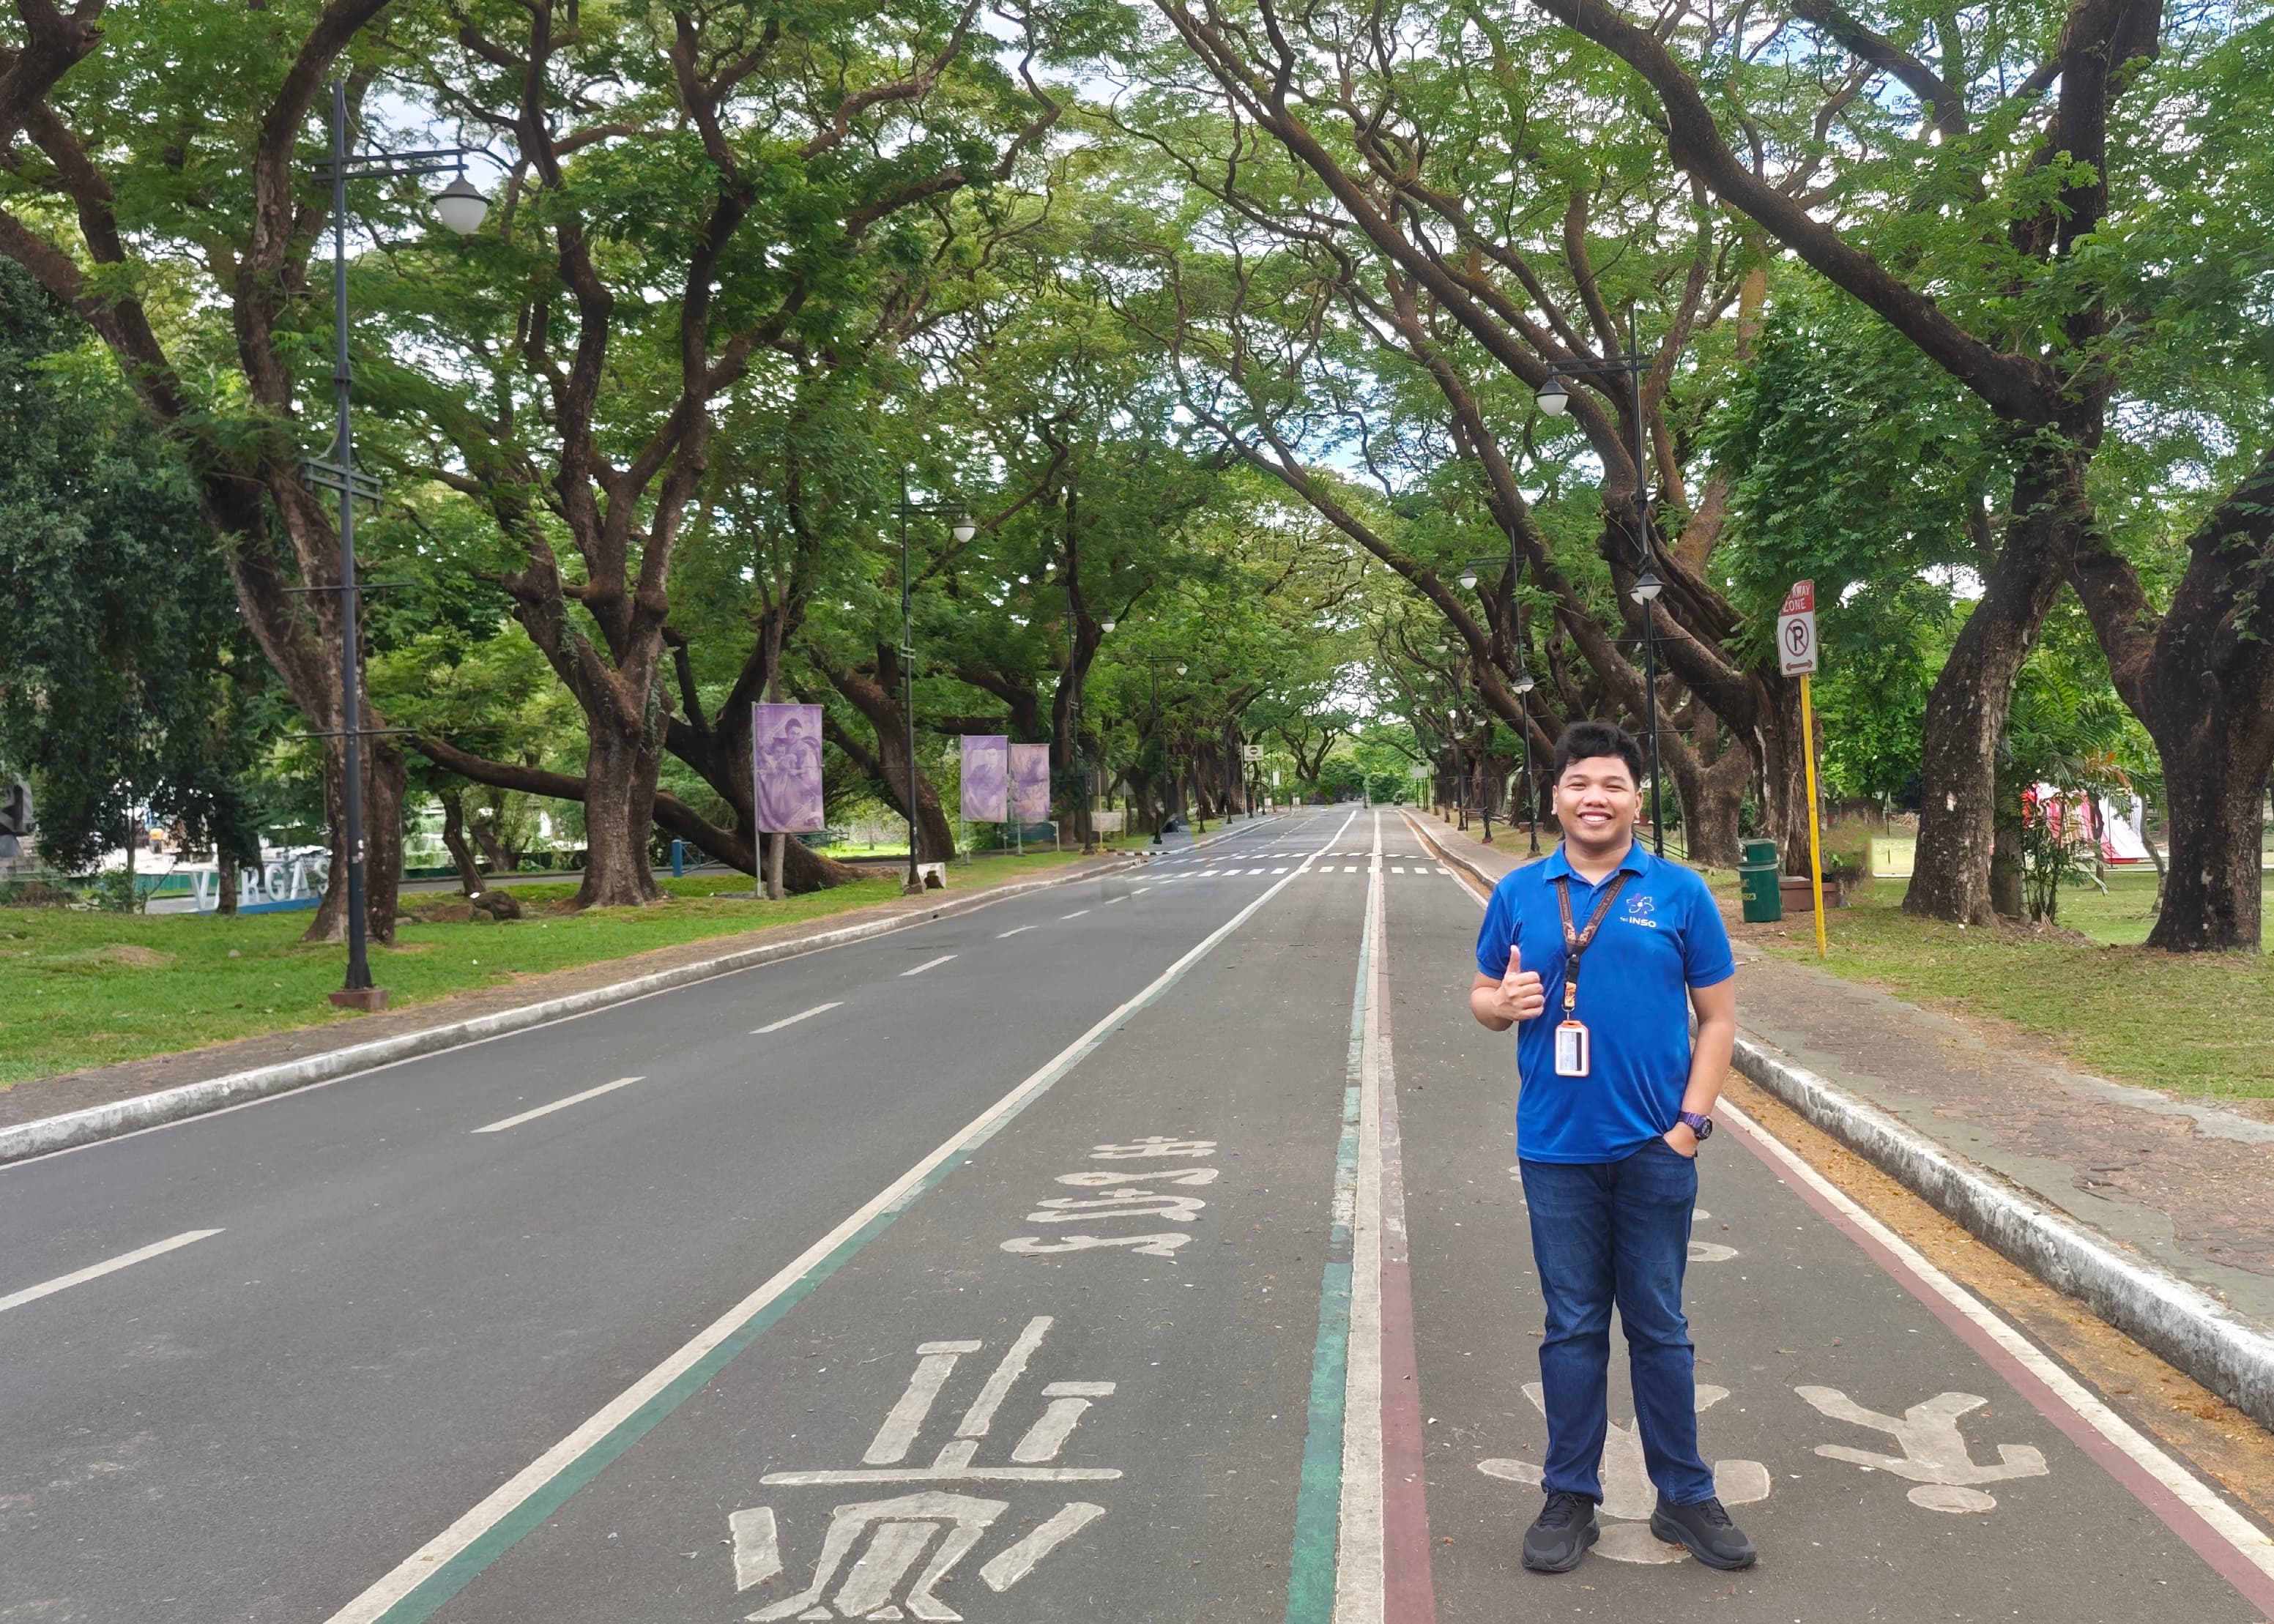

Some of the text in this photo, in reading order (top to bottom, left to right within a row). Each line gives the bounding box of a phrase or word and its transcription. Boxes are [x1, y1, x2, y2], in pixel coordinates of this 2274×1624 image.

[1792, 584, 1811, 598] AWAY
[190, 857, 330, 911] VRGAS
[1629, 916, 1657, 928] INSO
